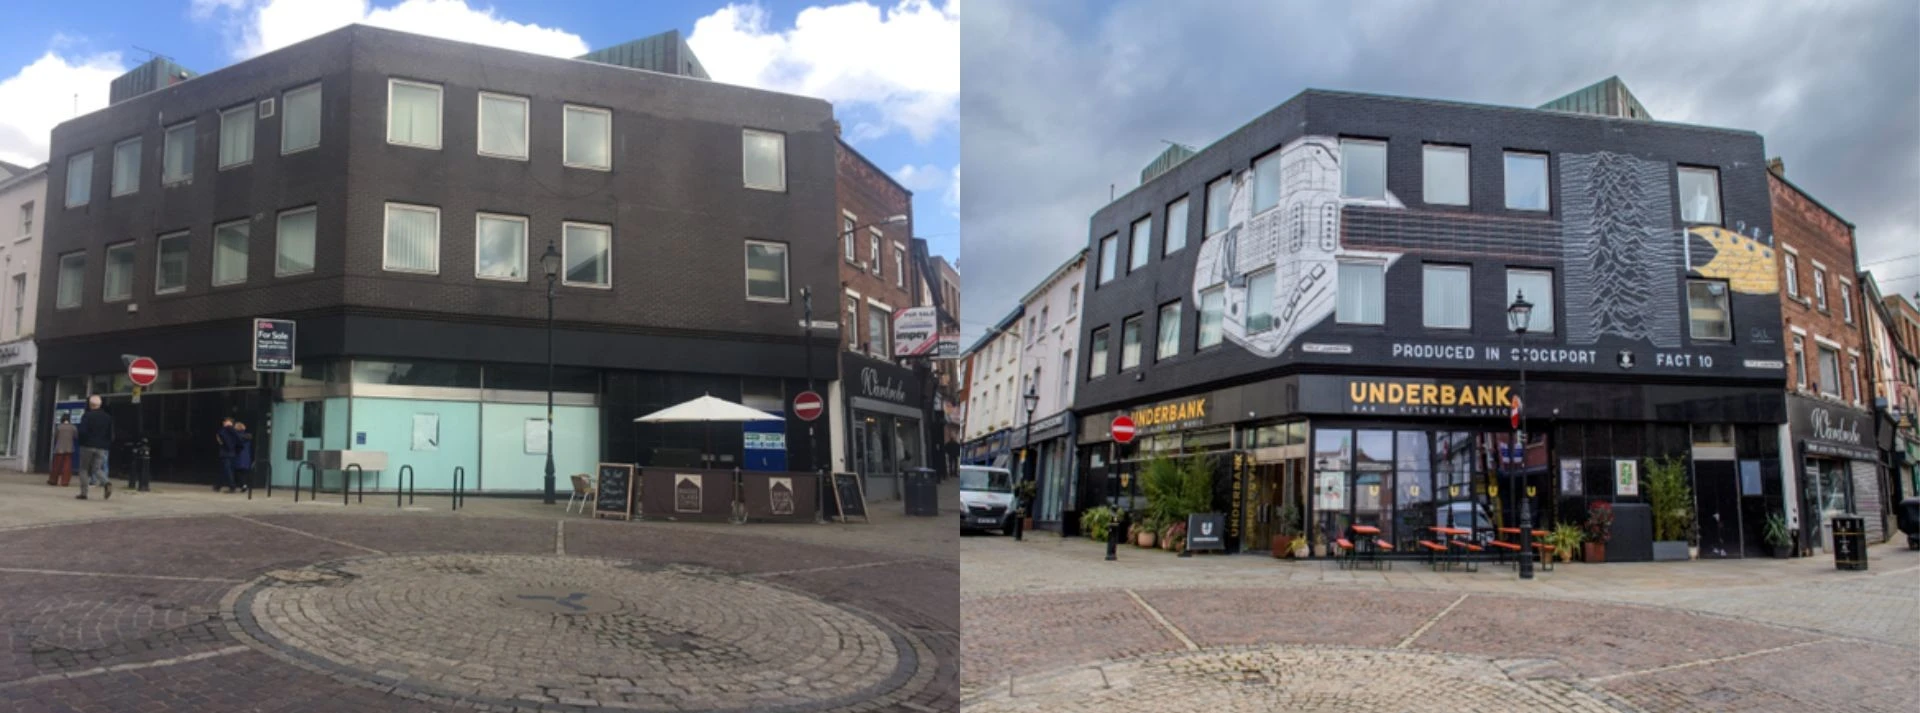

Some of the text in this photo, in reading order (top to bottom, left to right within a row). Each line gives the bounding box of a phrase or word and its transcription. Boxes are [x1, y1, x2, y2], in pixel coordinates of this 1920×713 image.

[258, 331, 289, 340] For Sale
[1392, 343, 1713, 368] PRODUCED IN STOCKPORT FACT 10
[1350, 382, 1512, 406] UNDERBANK
[1352, 405, 1508, 416] BAR KITCHEN MUSIC
[1231, 453, 1243, 537] UNDERBANK
[1201, 522, 1213, 535] U
